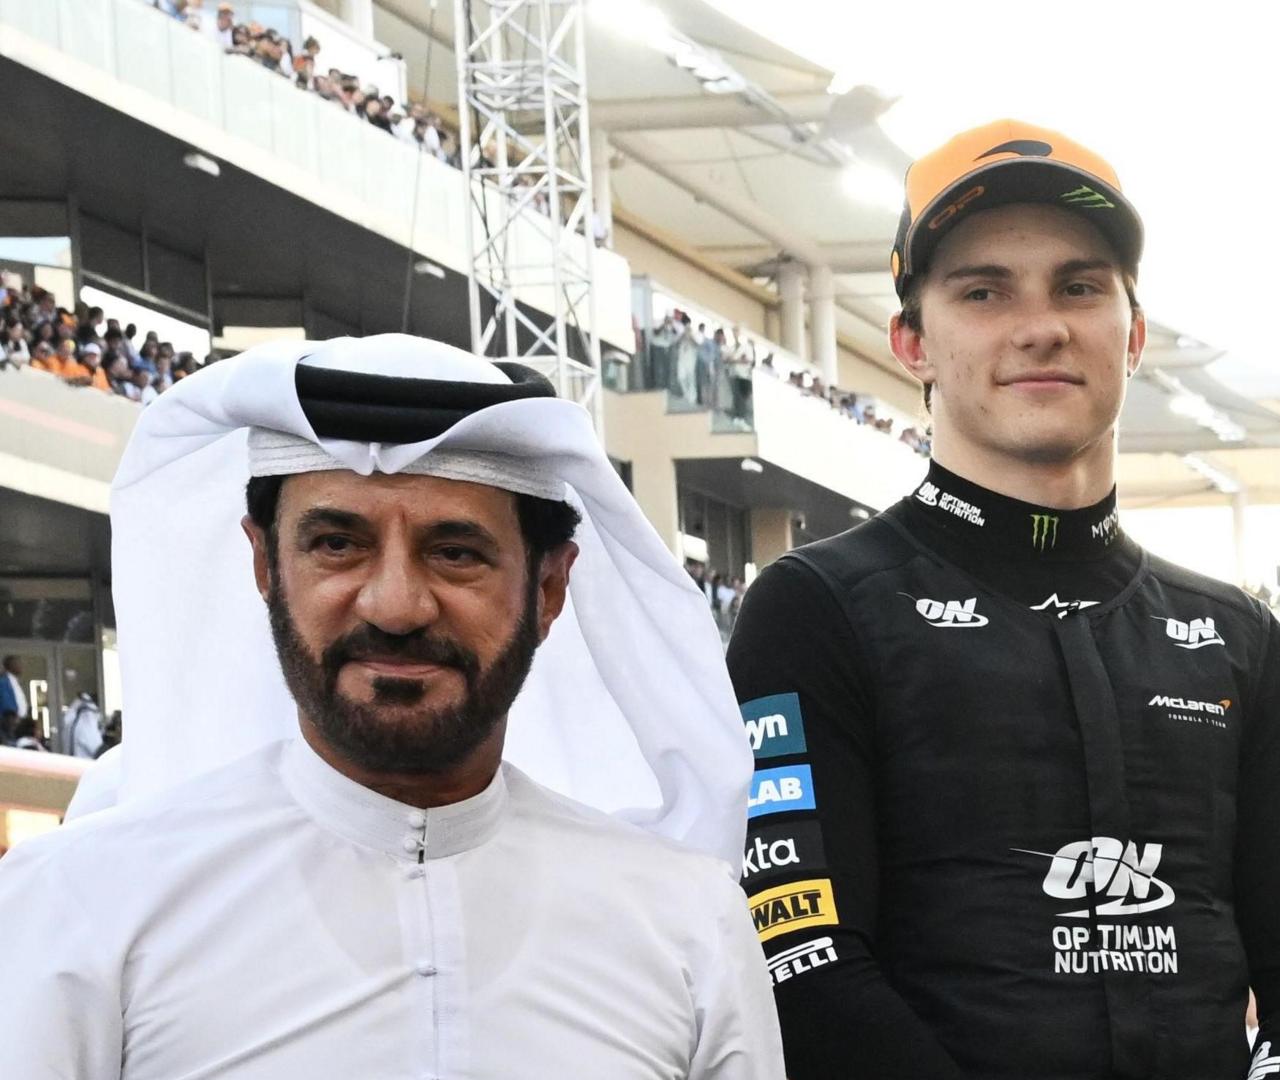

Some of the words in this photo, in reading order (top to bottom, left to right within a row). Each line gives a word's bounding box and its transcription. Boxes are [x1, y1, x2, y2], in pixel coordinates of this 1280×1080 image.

[938, 500, 986, 527] NUTRITION
[940, 491, 982, 516] OPTIMUM
[1148, 694, 1226, 717] McLaren
[1052, 924, 1177, 950] OPTIMUM
[1054, 950, 1179, 975] NUTRITION
